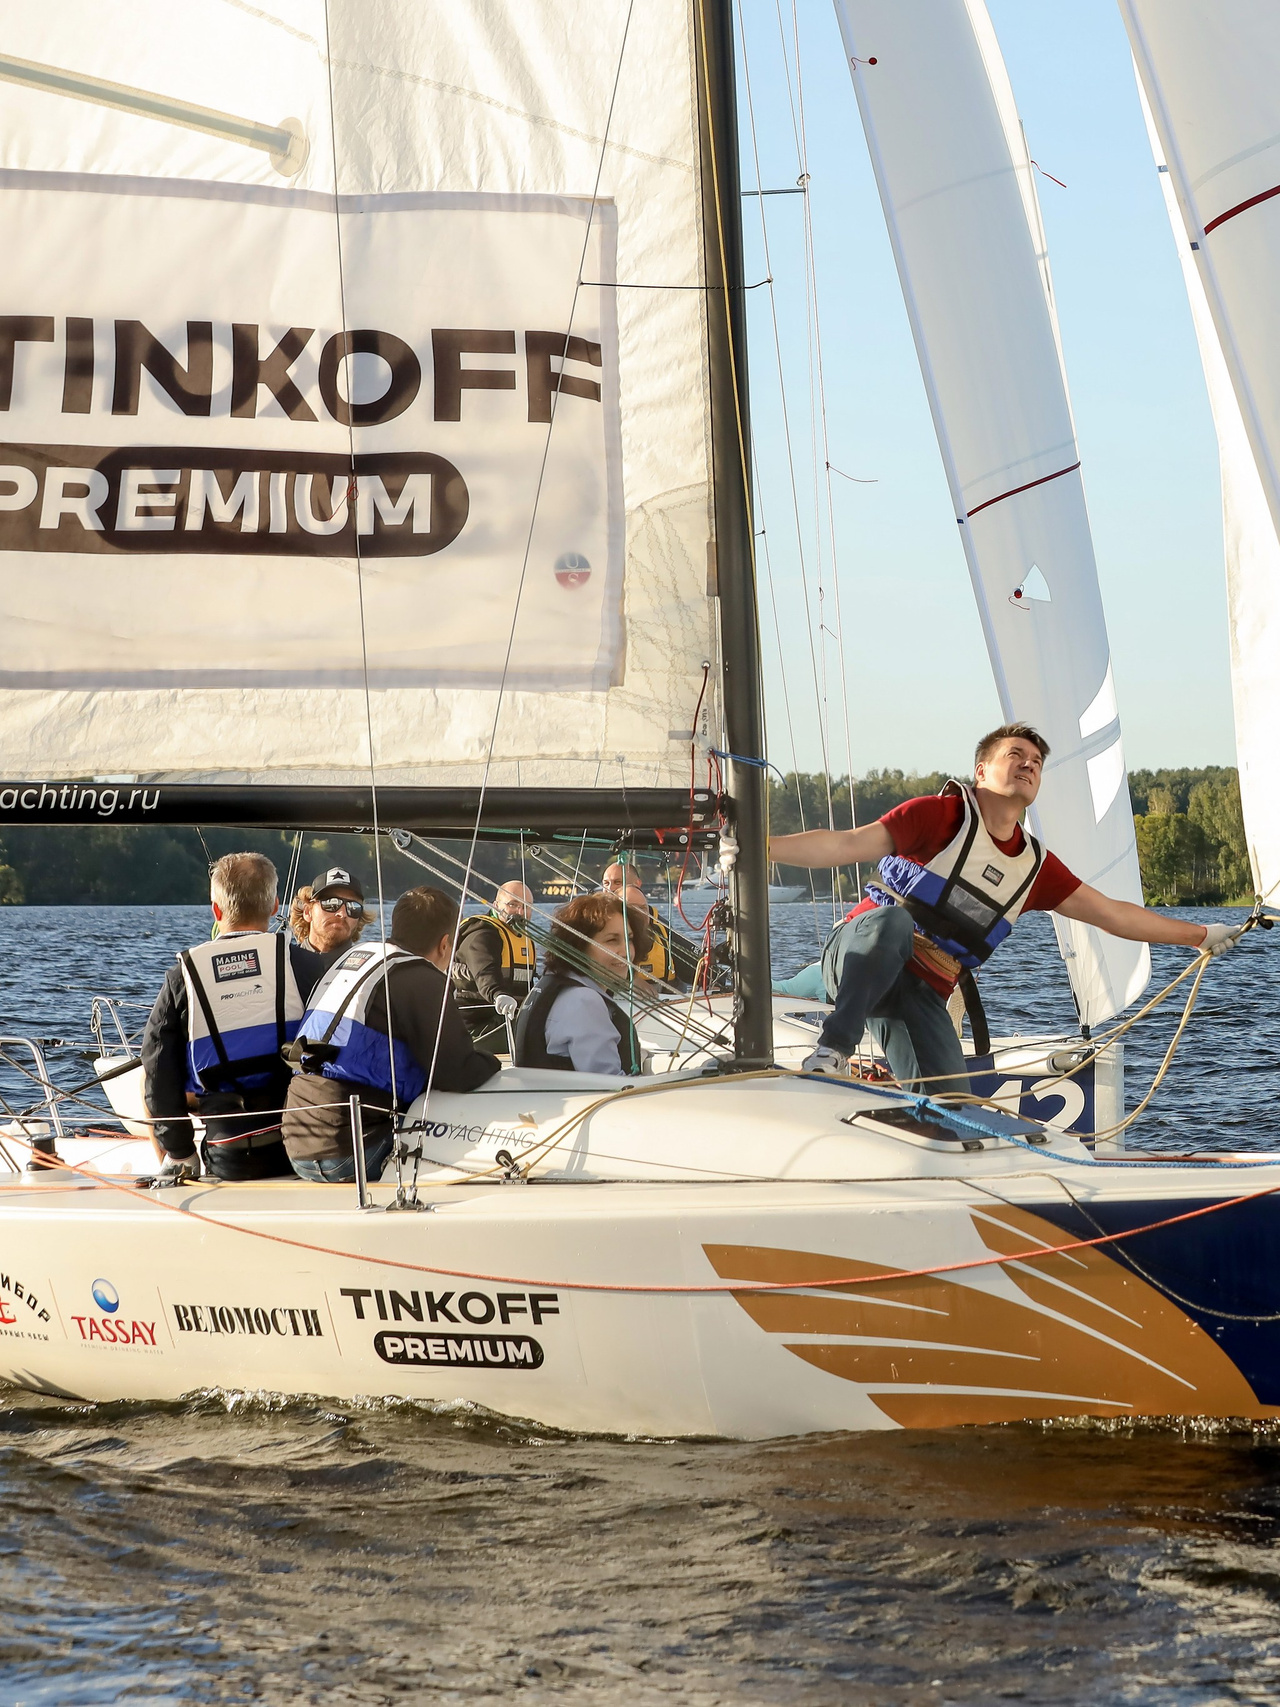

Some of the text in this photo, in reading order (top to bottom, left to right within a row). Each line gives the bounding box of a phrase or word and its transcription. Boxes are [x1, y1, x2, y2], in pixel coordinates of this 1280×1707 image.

[0, 315, 603, 427] TINKOFF
[0, 465, 433, 536] PREMIUM
[0, 783, 161, 816] achting.ru
[216, 953, 255, 966] MARINE
[220, 964, 242, 972] POOL
[172, 1304, 324, 1337] ВЕДОМОСТИ
[340, 1288, 560, 1325] TINKOFF
[71, 1316, 157, 1345] TASSAY
[383, 1337, 534, 1363] PREMIUM
